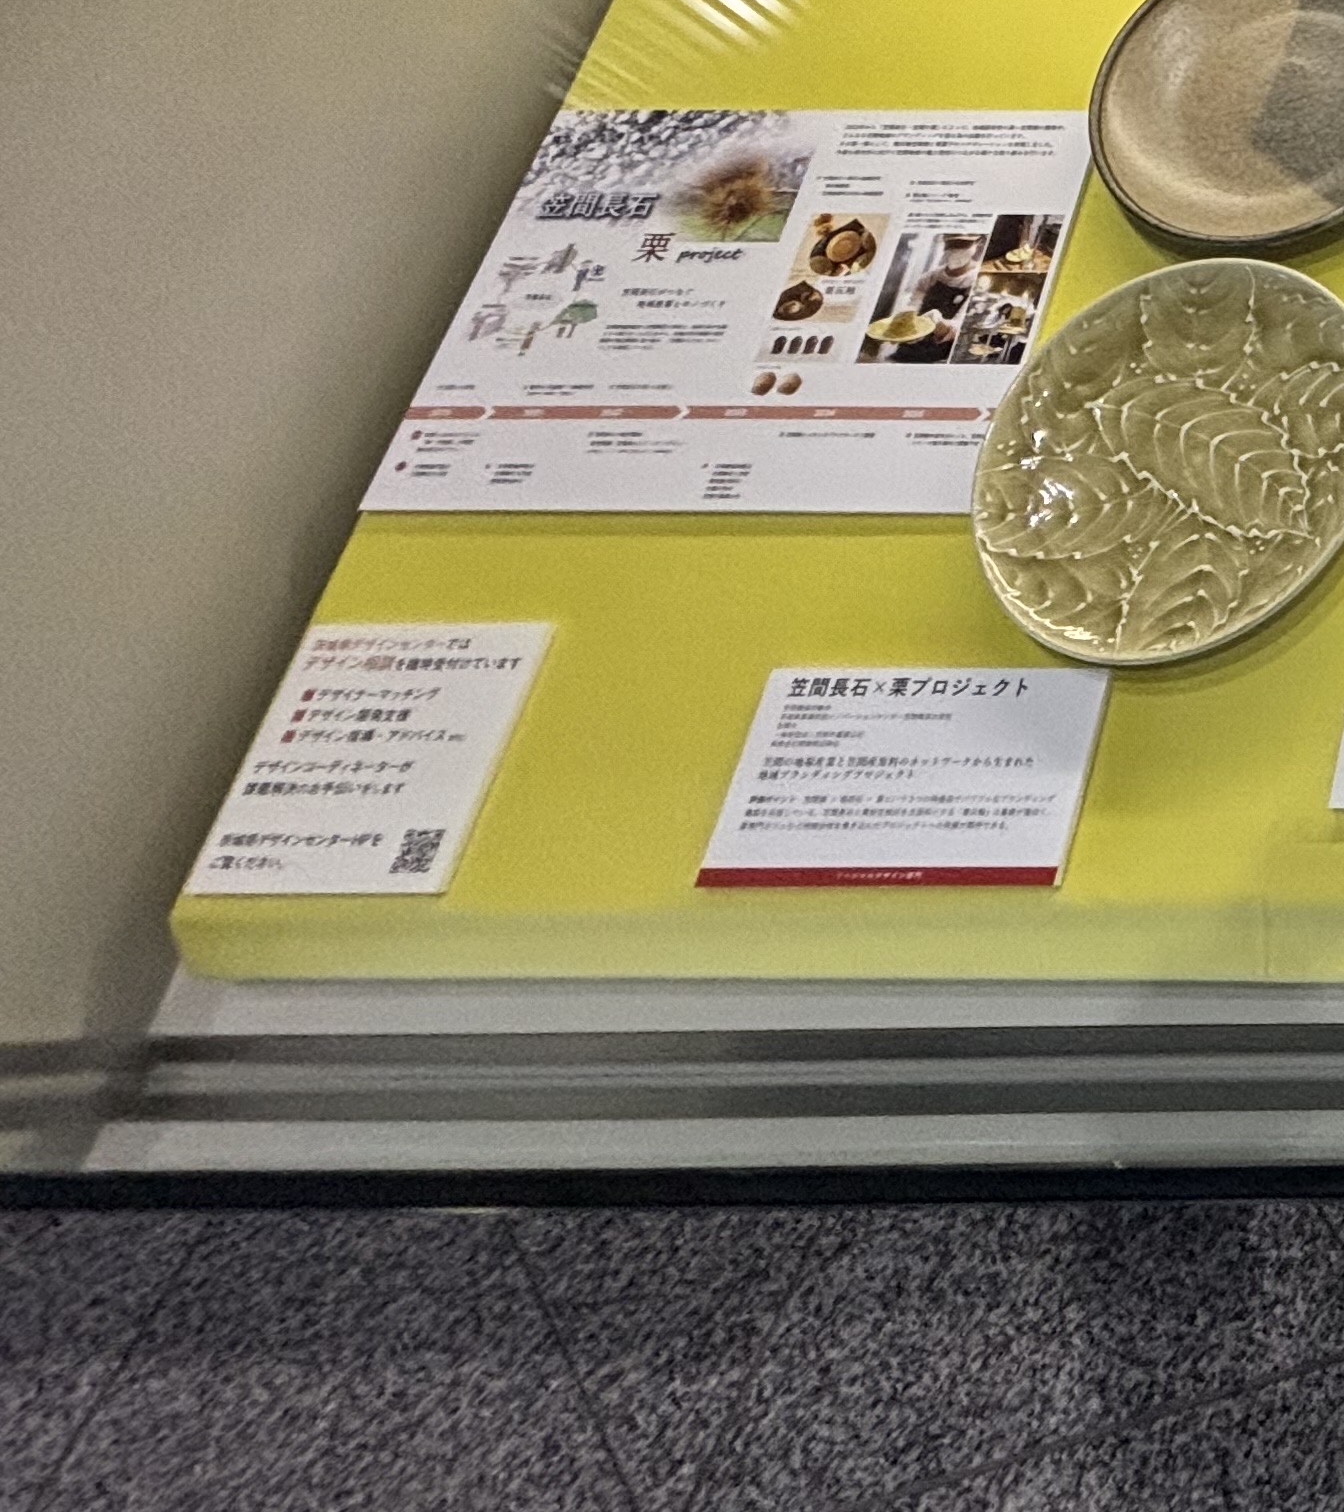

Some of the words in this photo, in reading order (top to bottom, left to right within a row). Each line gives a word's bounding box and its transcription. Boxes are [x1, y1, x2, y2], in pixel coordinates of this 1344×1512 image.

[536, 192, 661, 221] 笠間長石
[631, 232, 676, 263] 栗
[676, 246, 745, 263] project
[787, 677, 1030, 698] 笠間長石×栗プロジェクト
